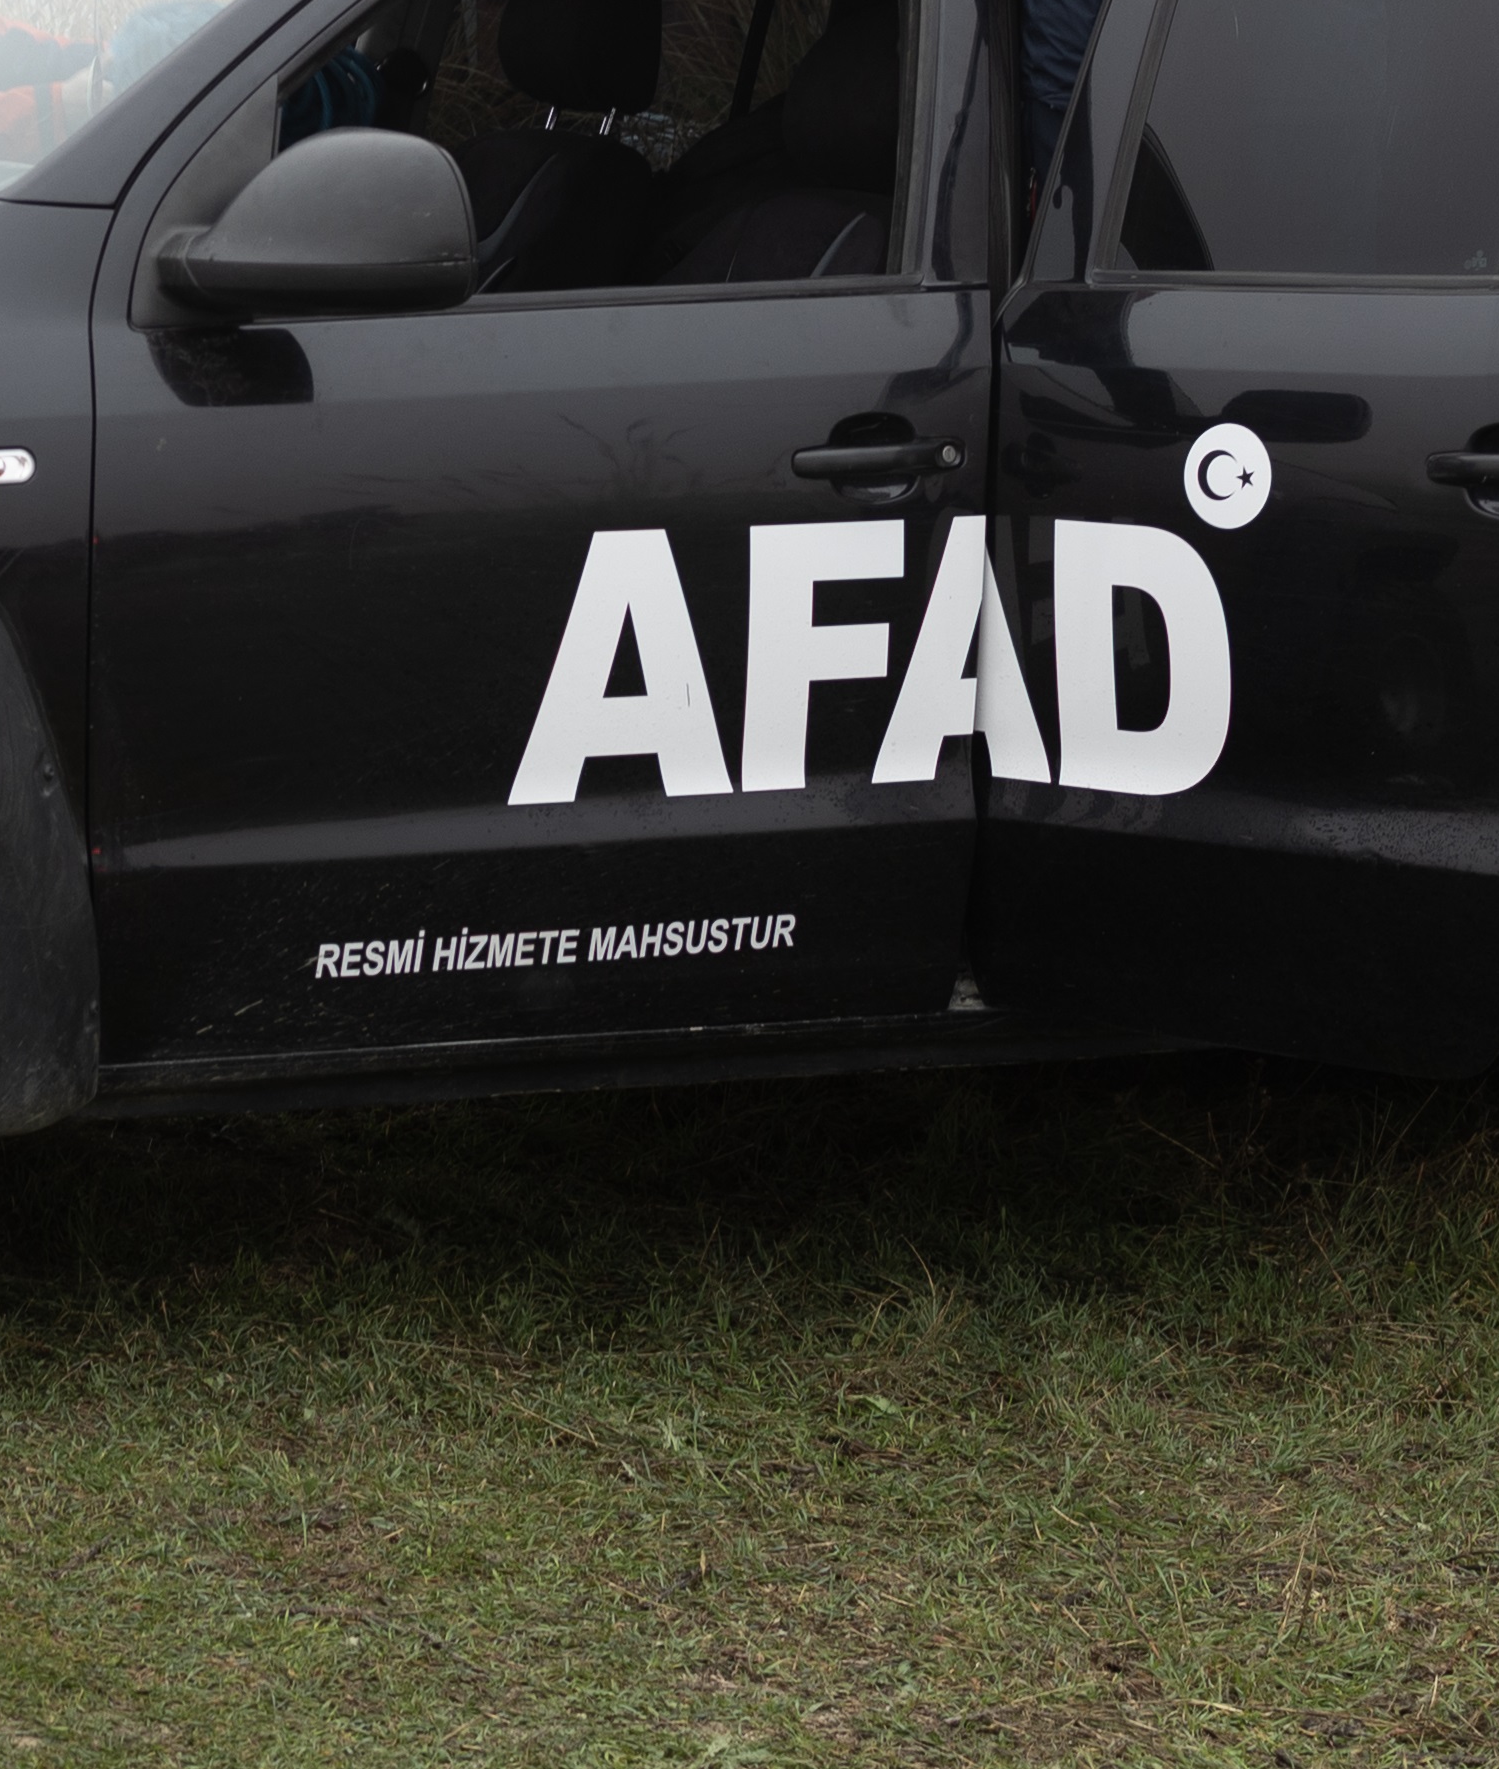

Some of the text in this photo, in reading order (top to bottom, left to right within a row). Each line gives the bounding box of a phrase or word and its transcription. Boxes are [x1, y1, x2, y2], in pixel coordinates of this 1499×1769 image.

[507, 515, 1232, 805] AFAD
[315, 913, 797, 979] RESMİ HİZMETE MAHSUSTUR
